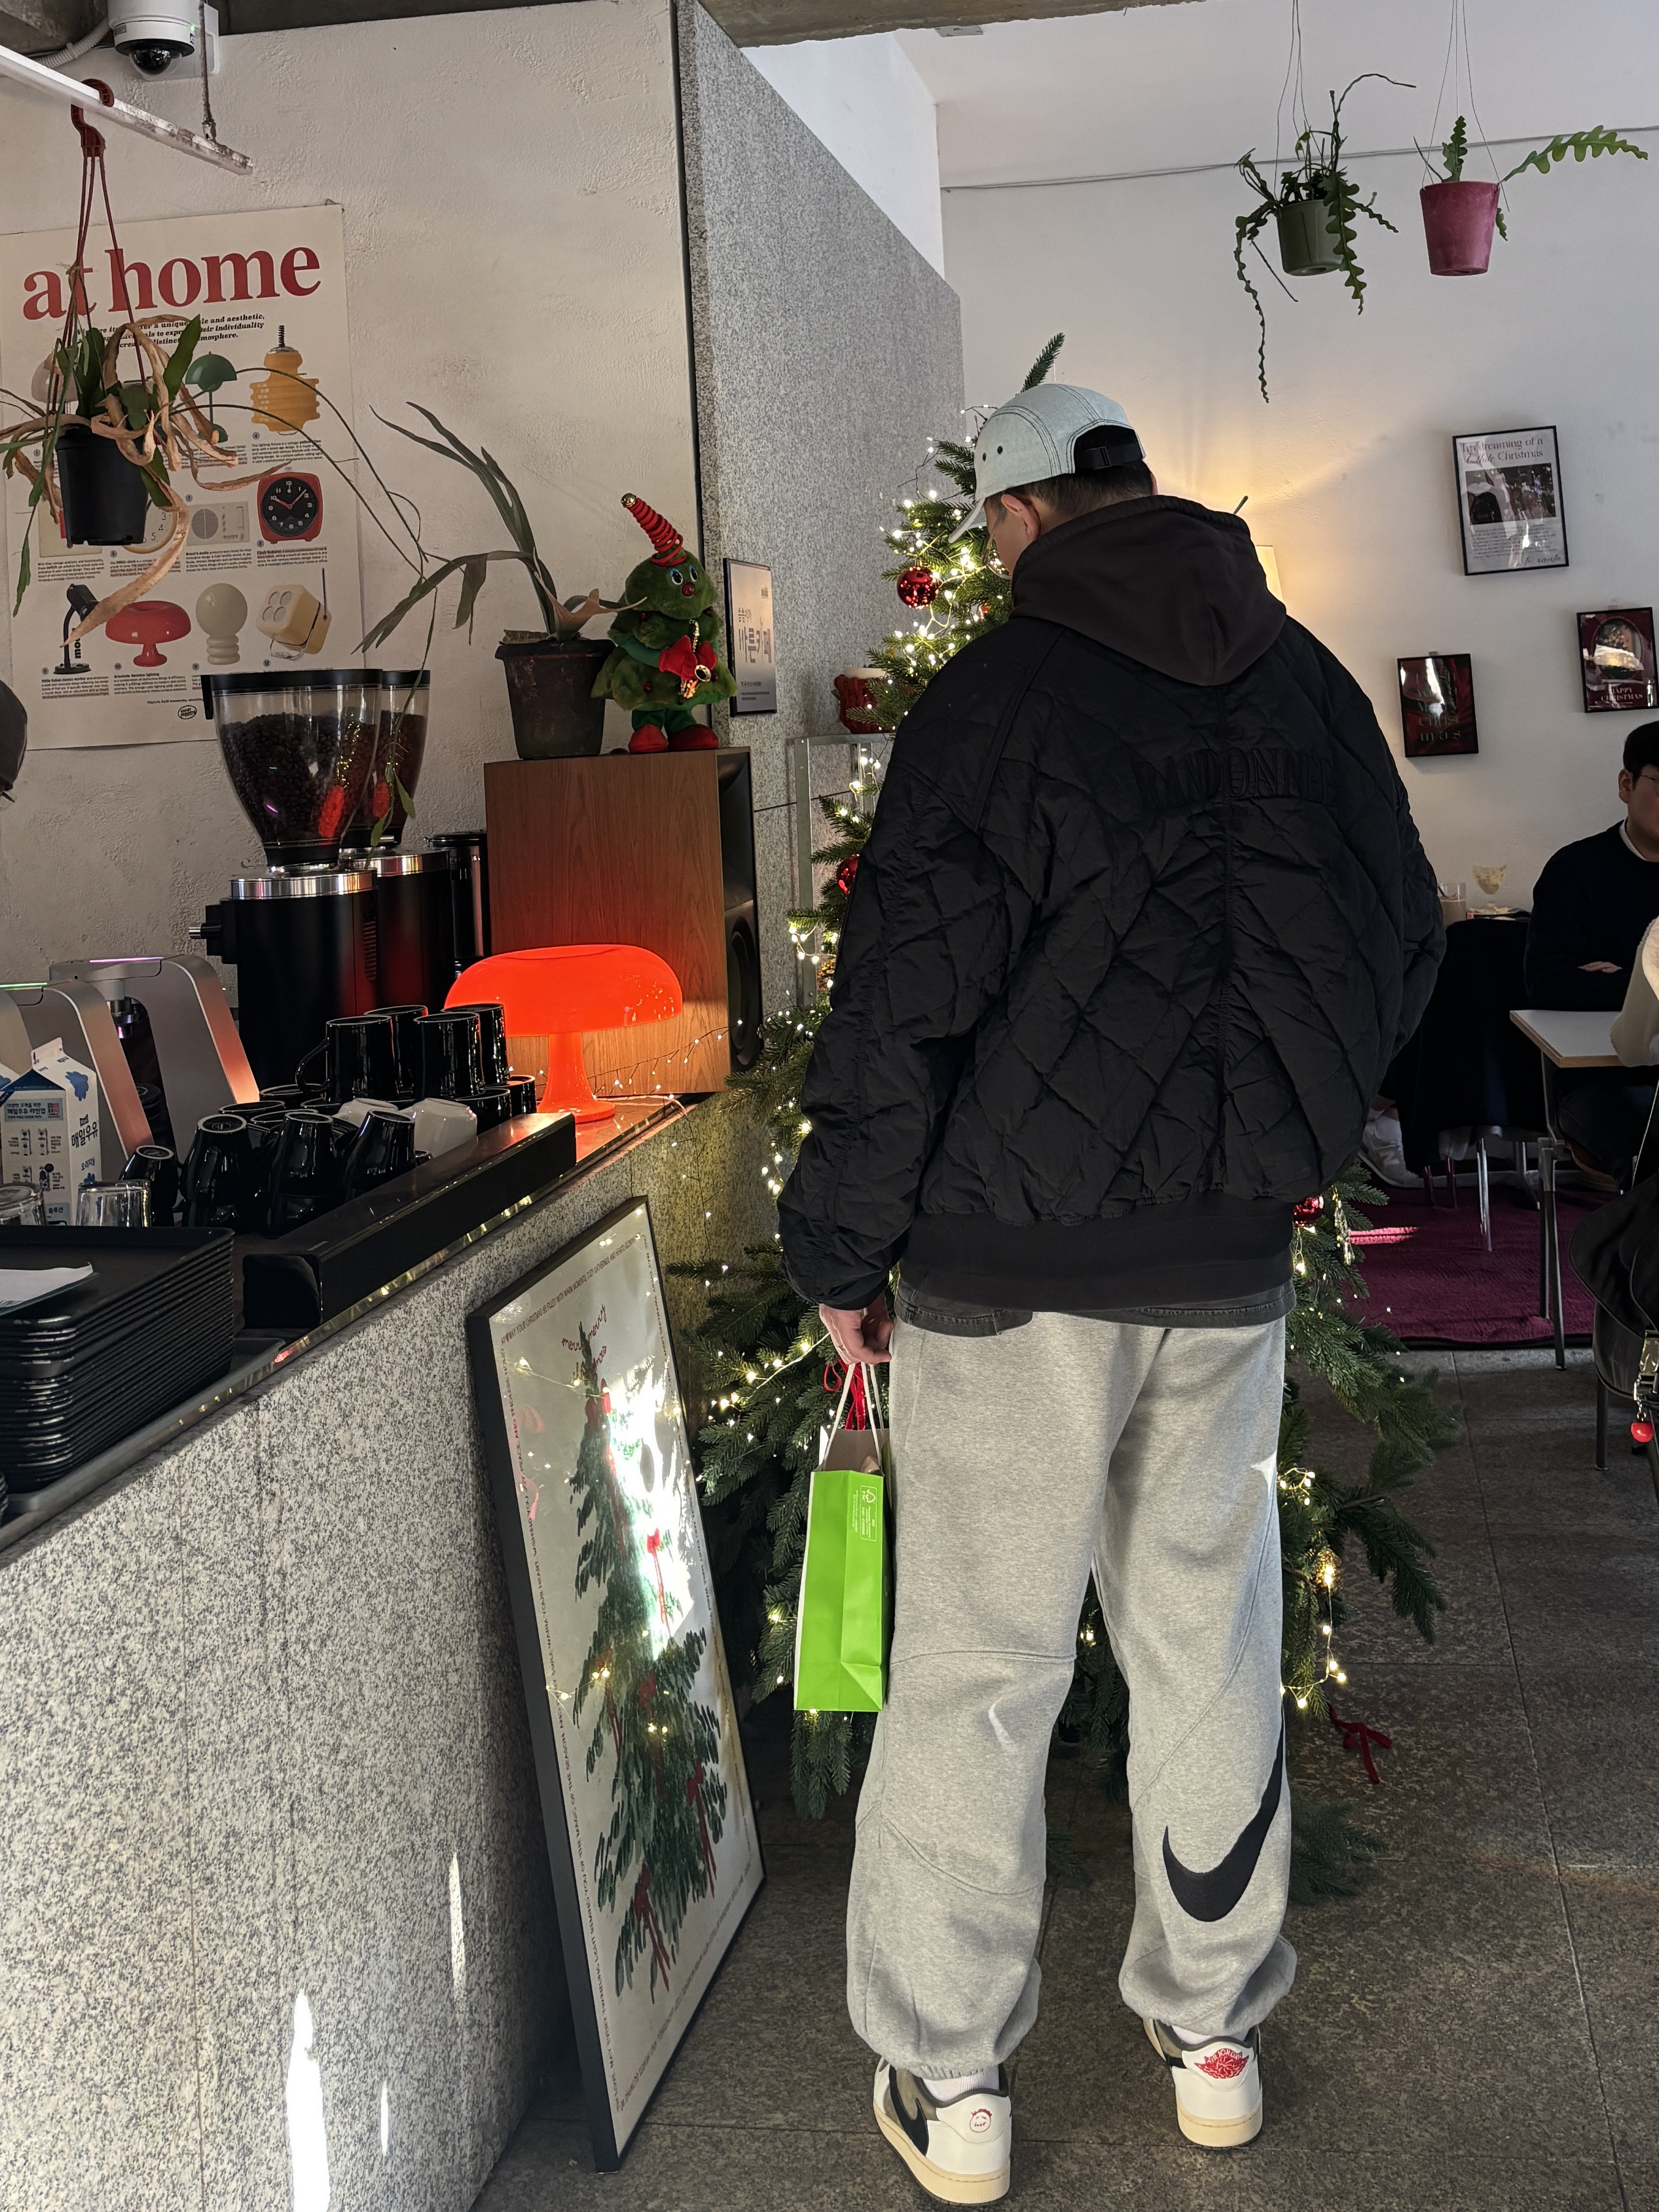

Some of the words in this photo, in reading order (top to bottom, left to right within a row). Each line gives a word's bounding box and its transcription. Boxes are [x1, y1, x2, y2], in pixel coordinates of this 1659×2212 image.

[23, 265, 96, 320] at
[105, 247, 322, 313] home
[227, 313, 265, 322] aesthetic,
[215, 322, 264, 331] individuality
[1525, 437, 1535, 445] of
[1497, 450, 1544, 461] Christmas
[151, 532, 156, 541] 5
[71, 1121, 99, 1148] 매일우유
[1217, 2048, 1243, 2060] JORDAN
